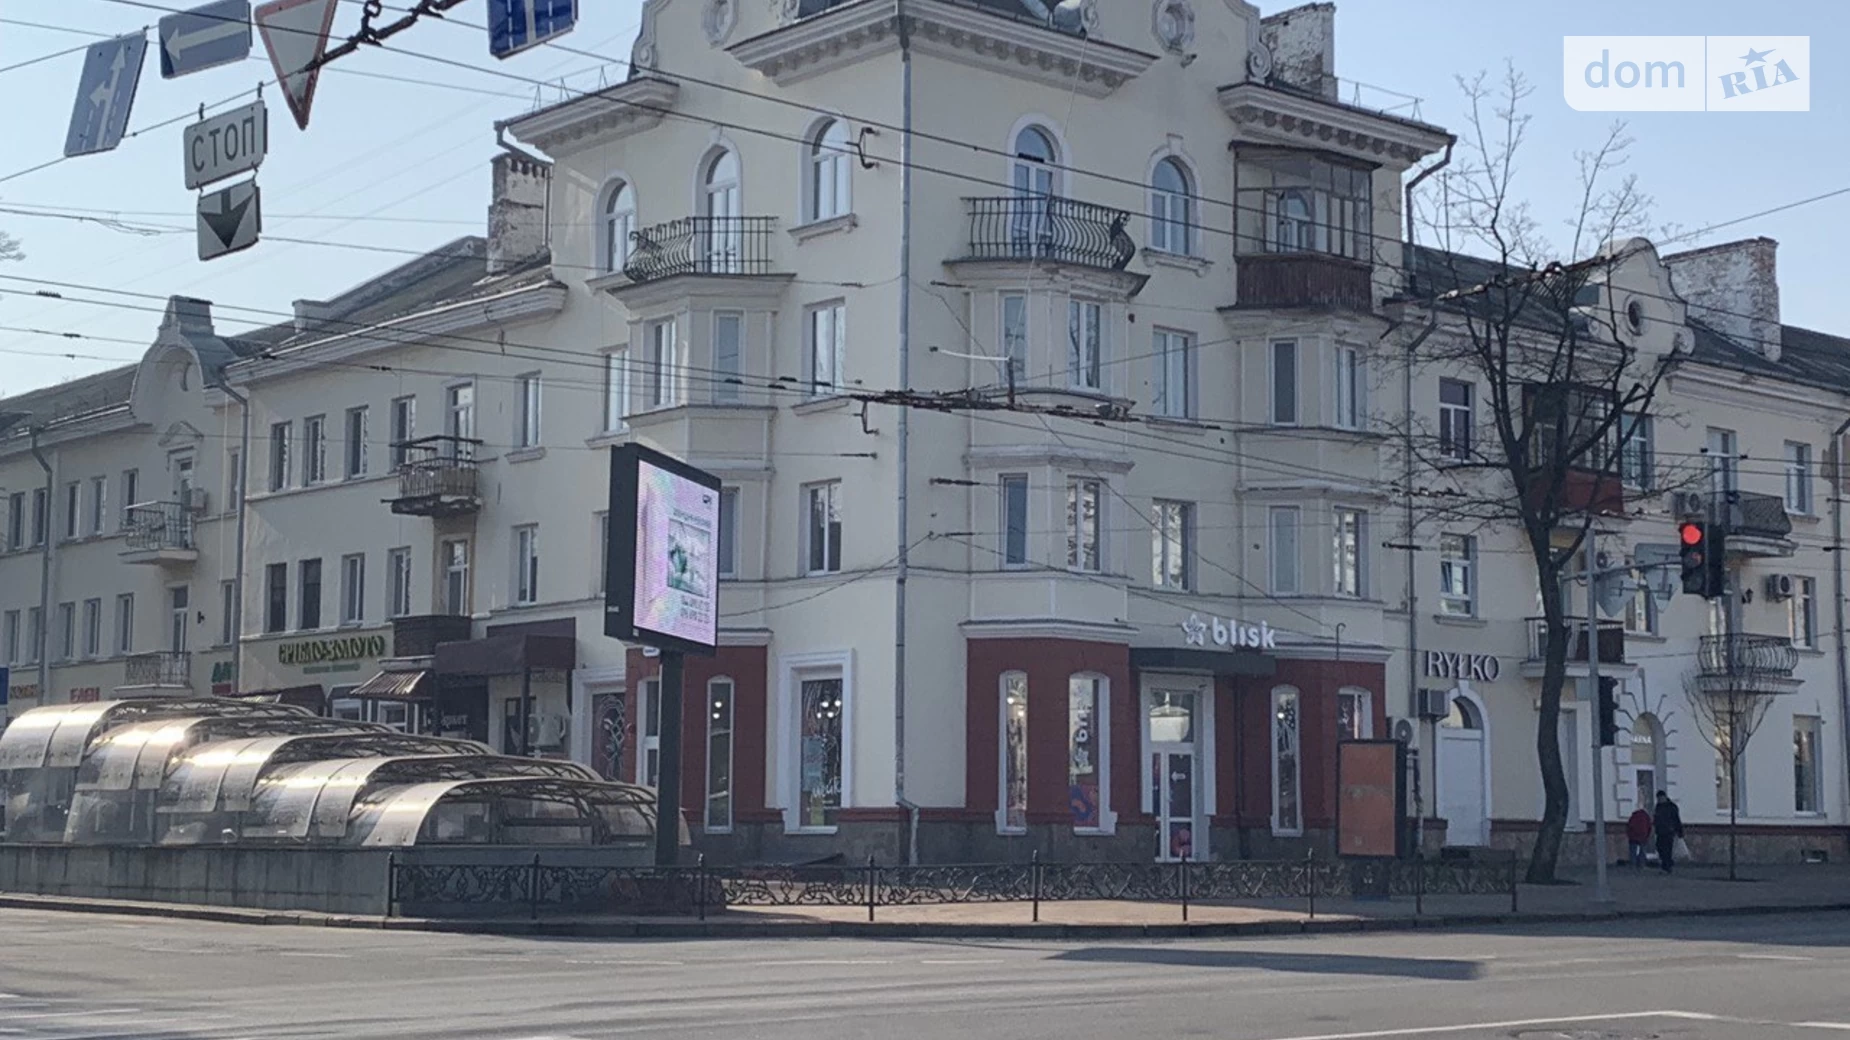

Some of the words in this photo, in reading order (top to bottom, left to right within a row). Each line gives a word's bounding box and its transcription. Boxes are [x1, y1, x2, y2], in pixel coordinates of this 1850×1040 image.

[191, 115, 256, 173] СТОП
[1212, 616, 1276, 649] blisk
[1425, 650, 1501, 681] RYŁKO
